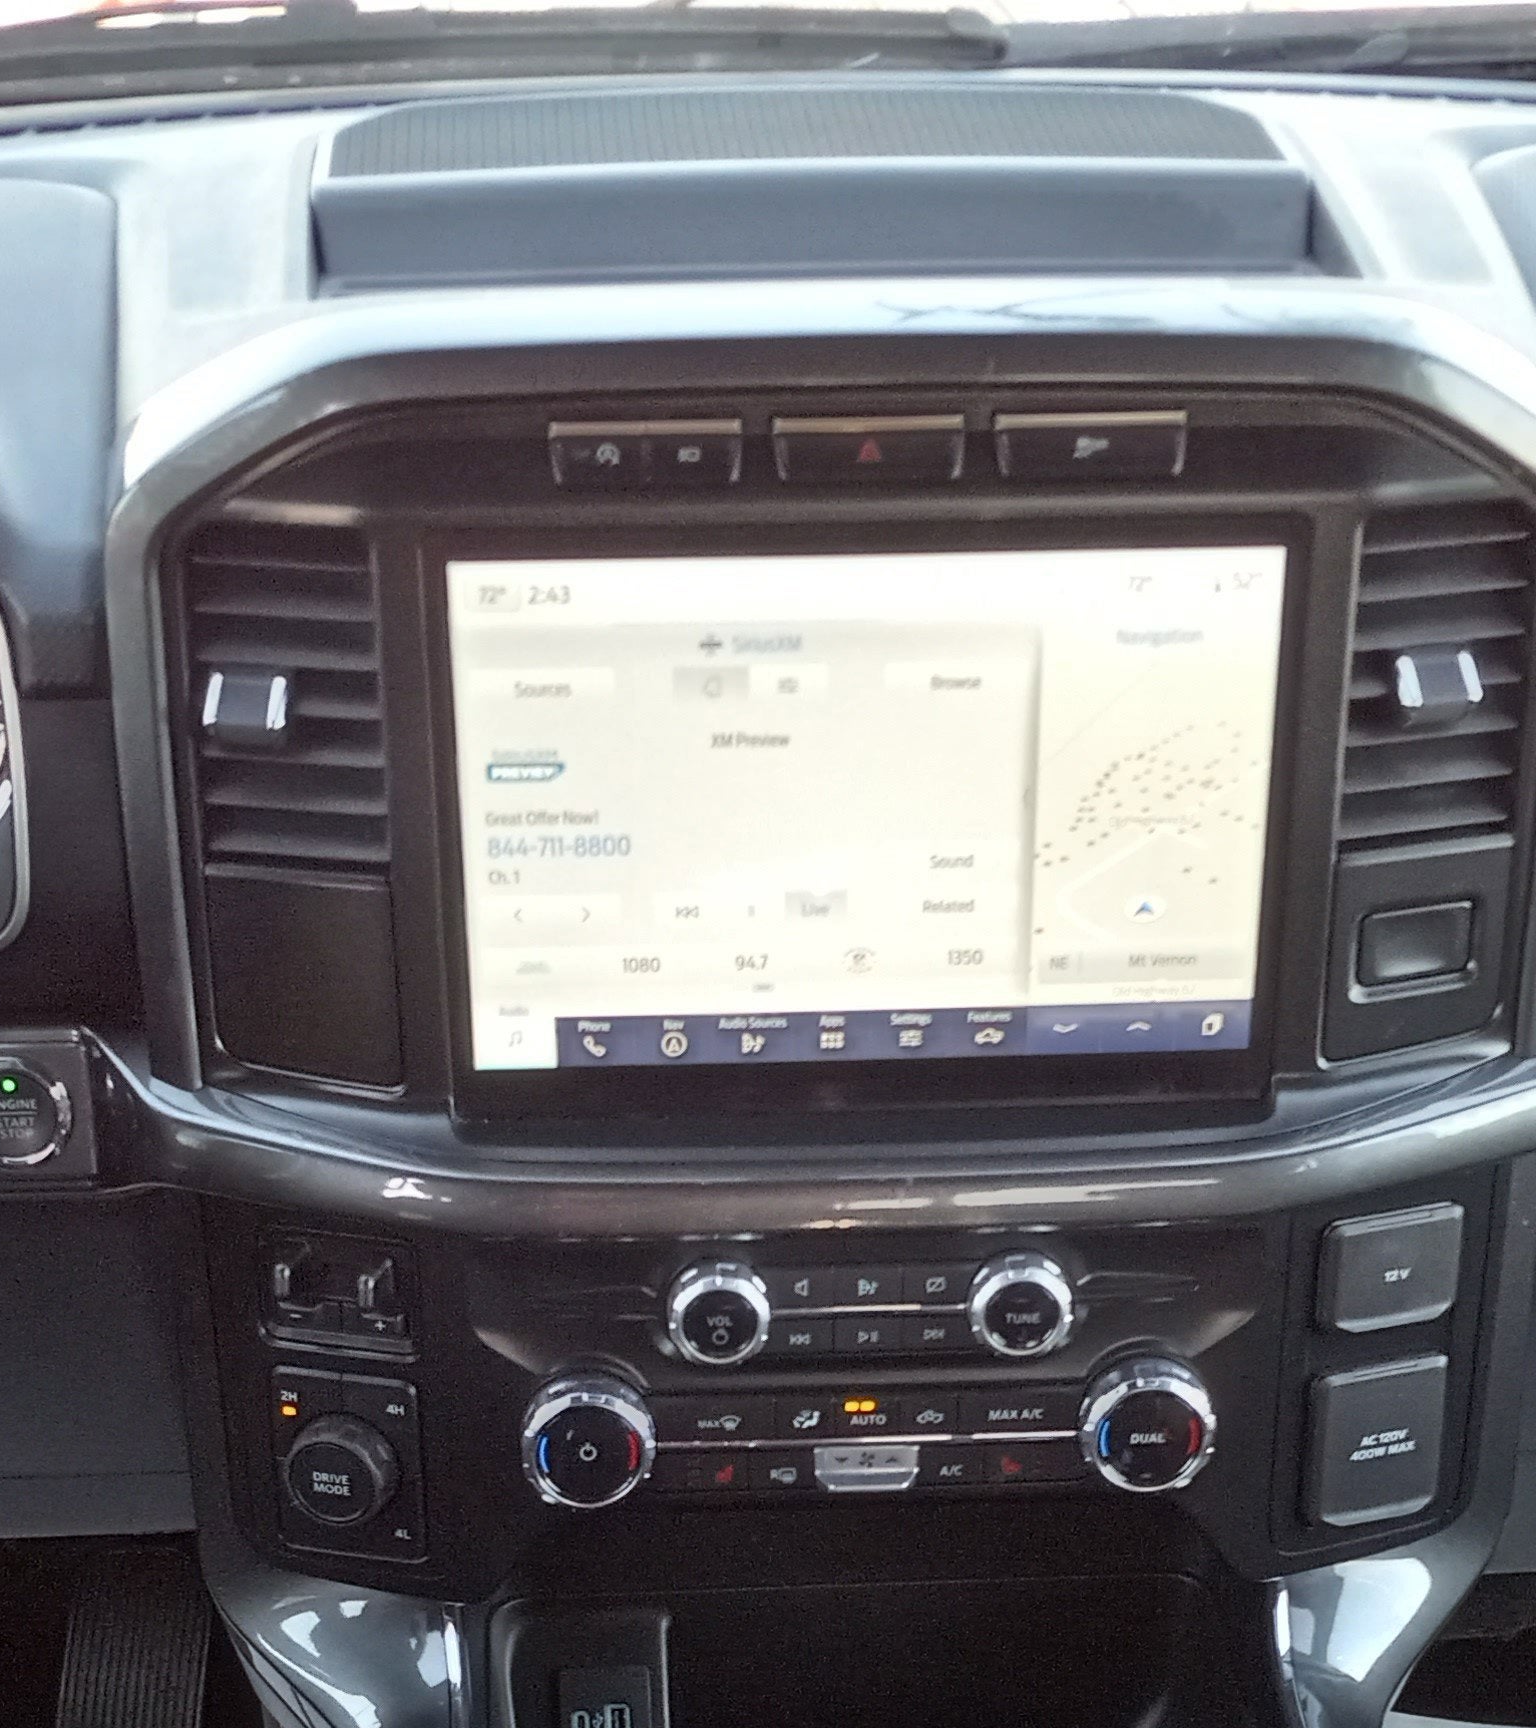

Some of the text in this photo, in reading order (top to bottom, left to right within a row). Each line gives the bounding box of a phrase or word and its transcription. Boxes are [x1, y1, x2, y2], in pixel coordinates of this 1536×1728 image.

[735, 732, 791, 749] Preview
[488, 834, 632, 857] 844-711-8800
[929, 854, 975, 869] Sound
[922, 899, 975, 914] Related
[730, 952, 769, 972] 94.7
[947, 947, 985, 967] 1350
[621, 955, 662, 974] 1080
[0, 1128, 35, 1139] STOP
[706, 1315, 733, 1329] VOL
[1004, 1311, 1041, 1325] TUNE
[280, 1391, 298, 1402] 2H
[386, 1404, 405, 1416] 4H
[987, 1407, 1044, 1422] MAX A/C
[850, 1414, 887, 1426] AUTO
[1129, 1432, 1167, 1445] DUAL
[313, 1470, 350, 1485] DRIVE
[939, 1464, 963, 1477] A/C
[313, 1482, 352, 1496] MODE
[394, 1529, 411, 1540] 4L
